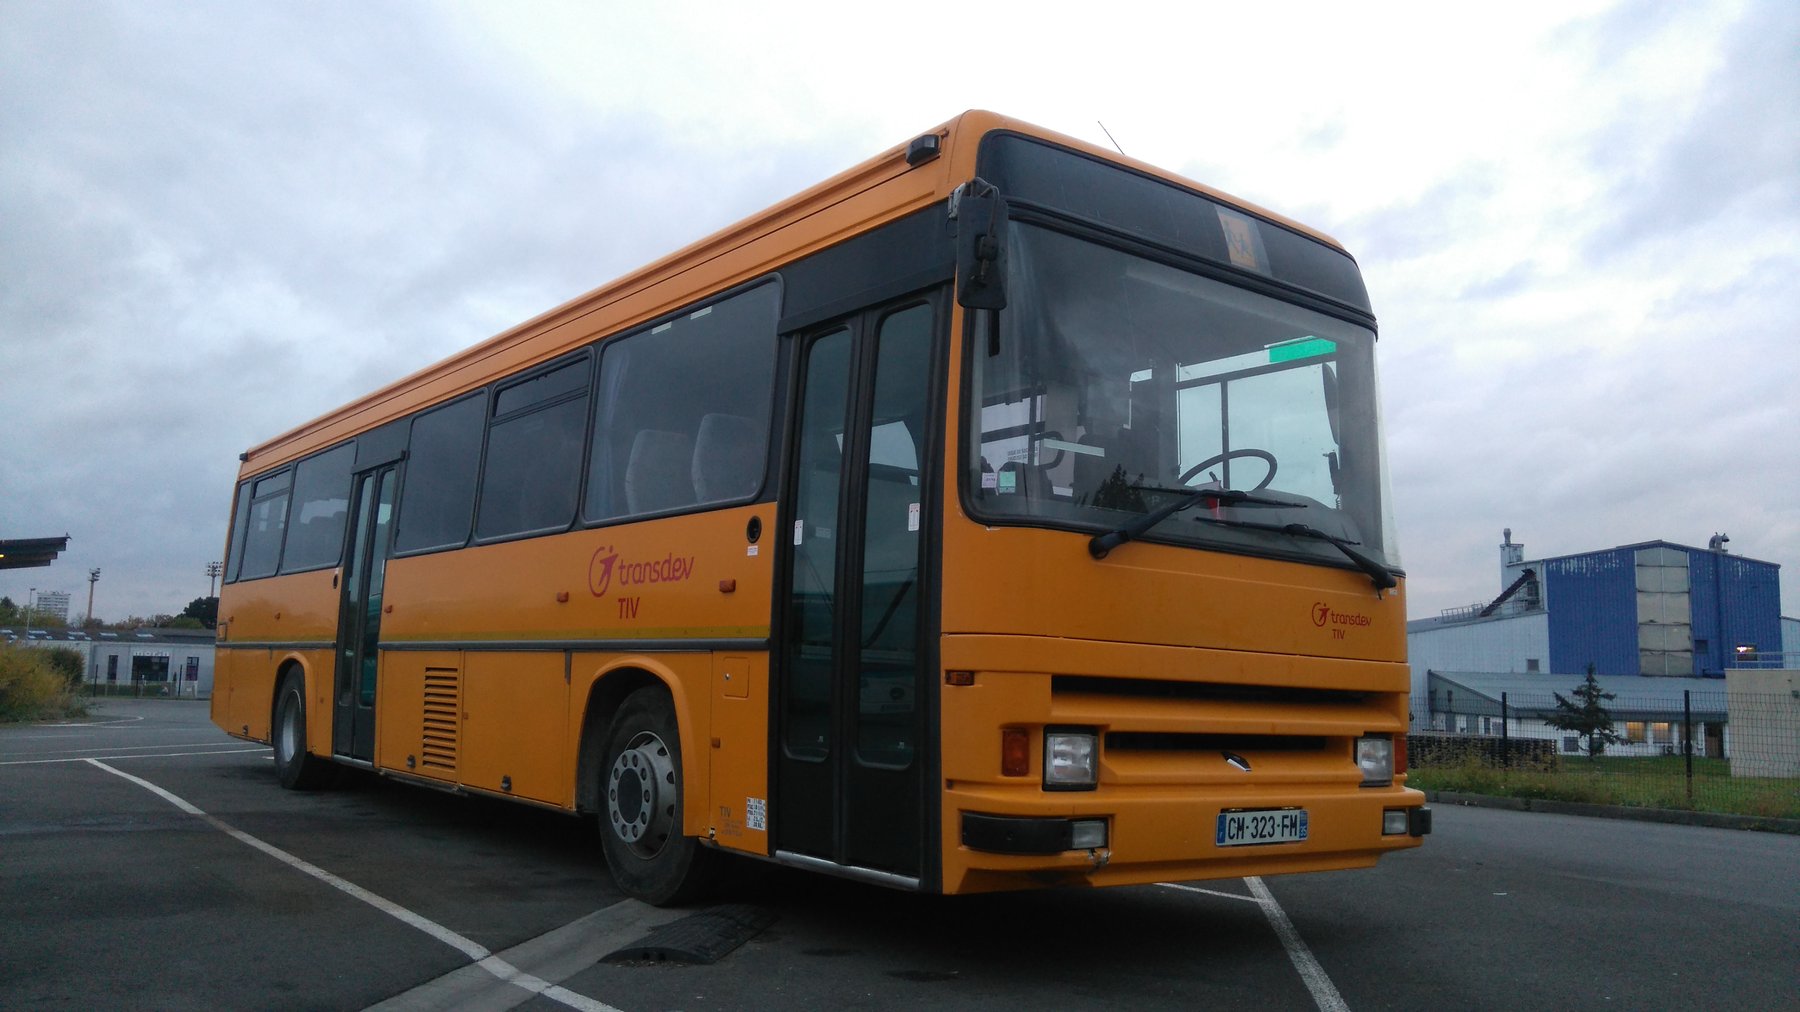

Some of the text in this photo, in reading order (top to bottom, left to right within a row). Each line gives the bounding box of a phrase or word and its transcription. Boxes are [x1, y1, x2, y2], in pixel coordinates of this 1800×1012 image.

[618, 552, 694, 586] transdev
[618, 596, 640, 619] TIV
[1331, 610, 1372, 626] transdev
[1332, 628, 1346, 640] TIV
